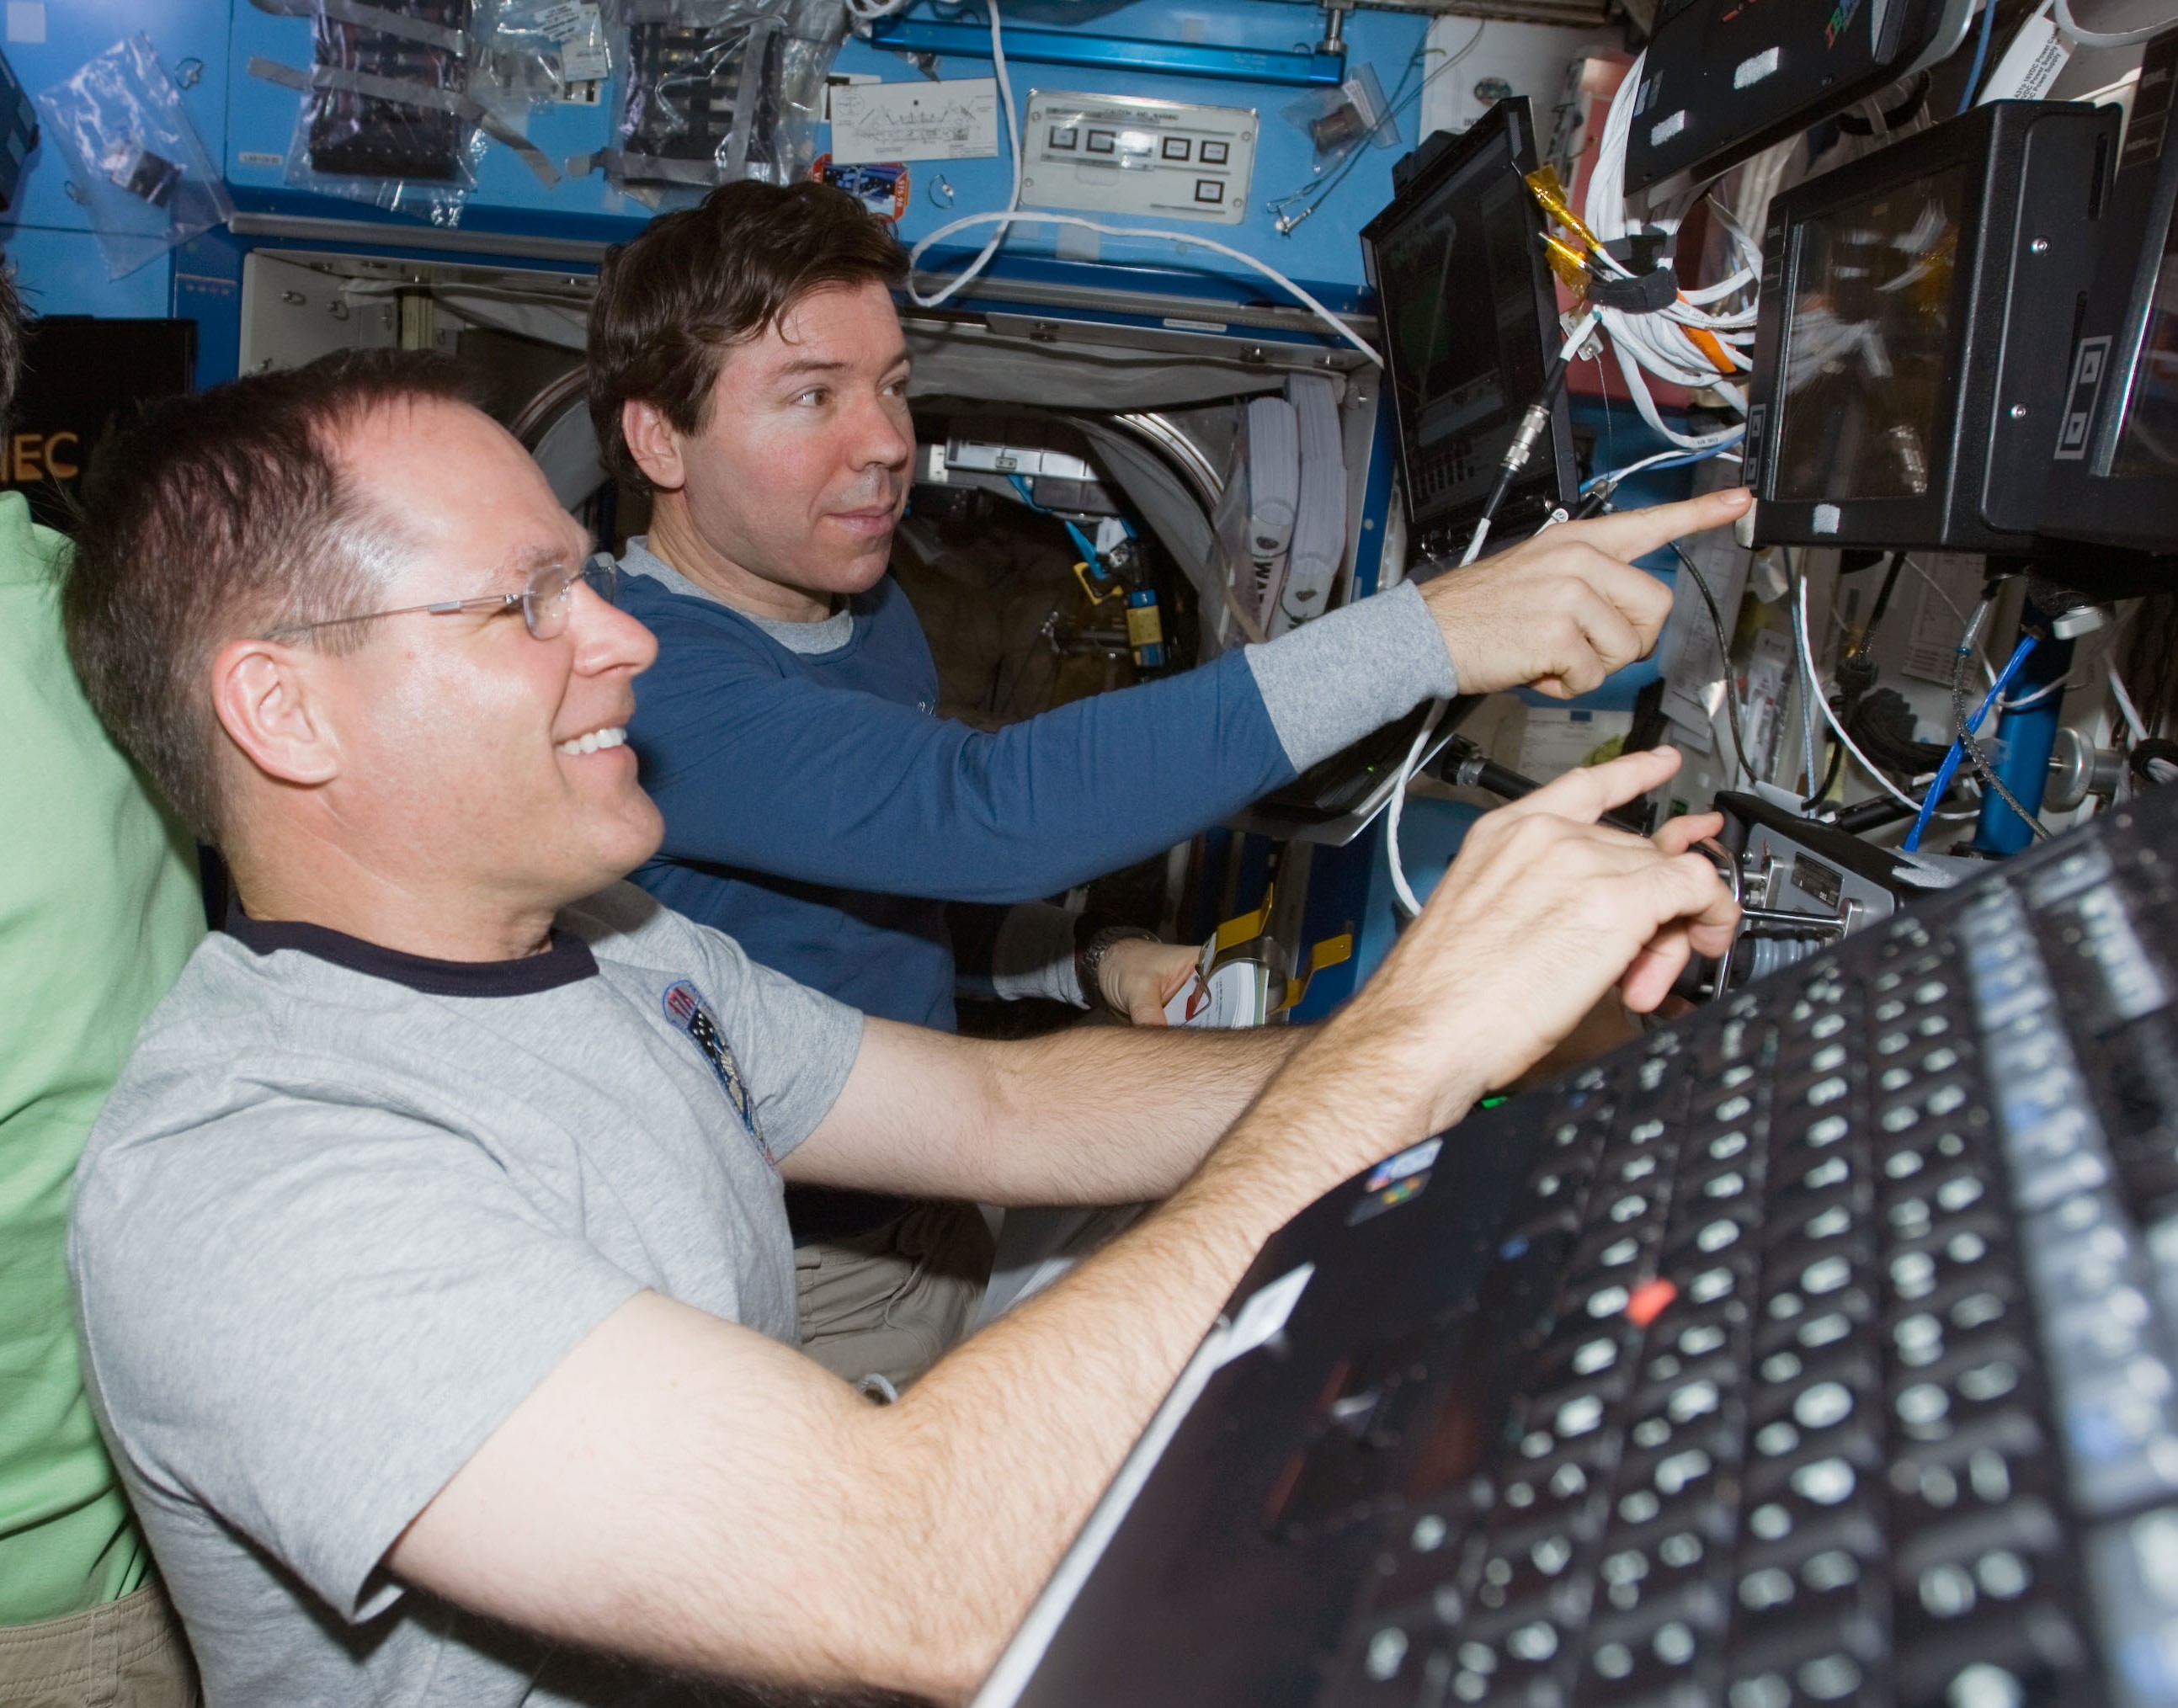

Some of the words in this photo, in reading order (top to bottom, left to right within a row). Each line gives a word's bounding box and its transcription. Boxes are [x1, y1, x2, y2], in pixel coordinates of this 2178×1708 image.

[2030, 67, 2044, 84] Power
[2042, 45, 2058, 66] Supply
[2033, 74, 2047, 92] Power
[2045, 53, 2061, 73] Supply
[2035, 45, 2050, 62] Power
